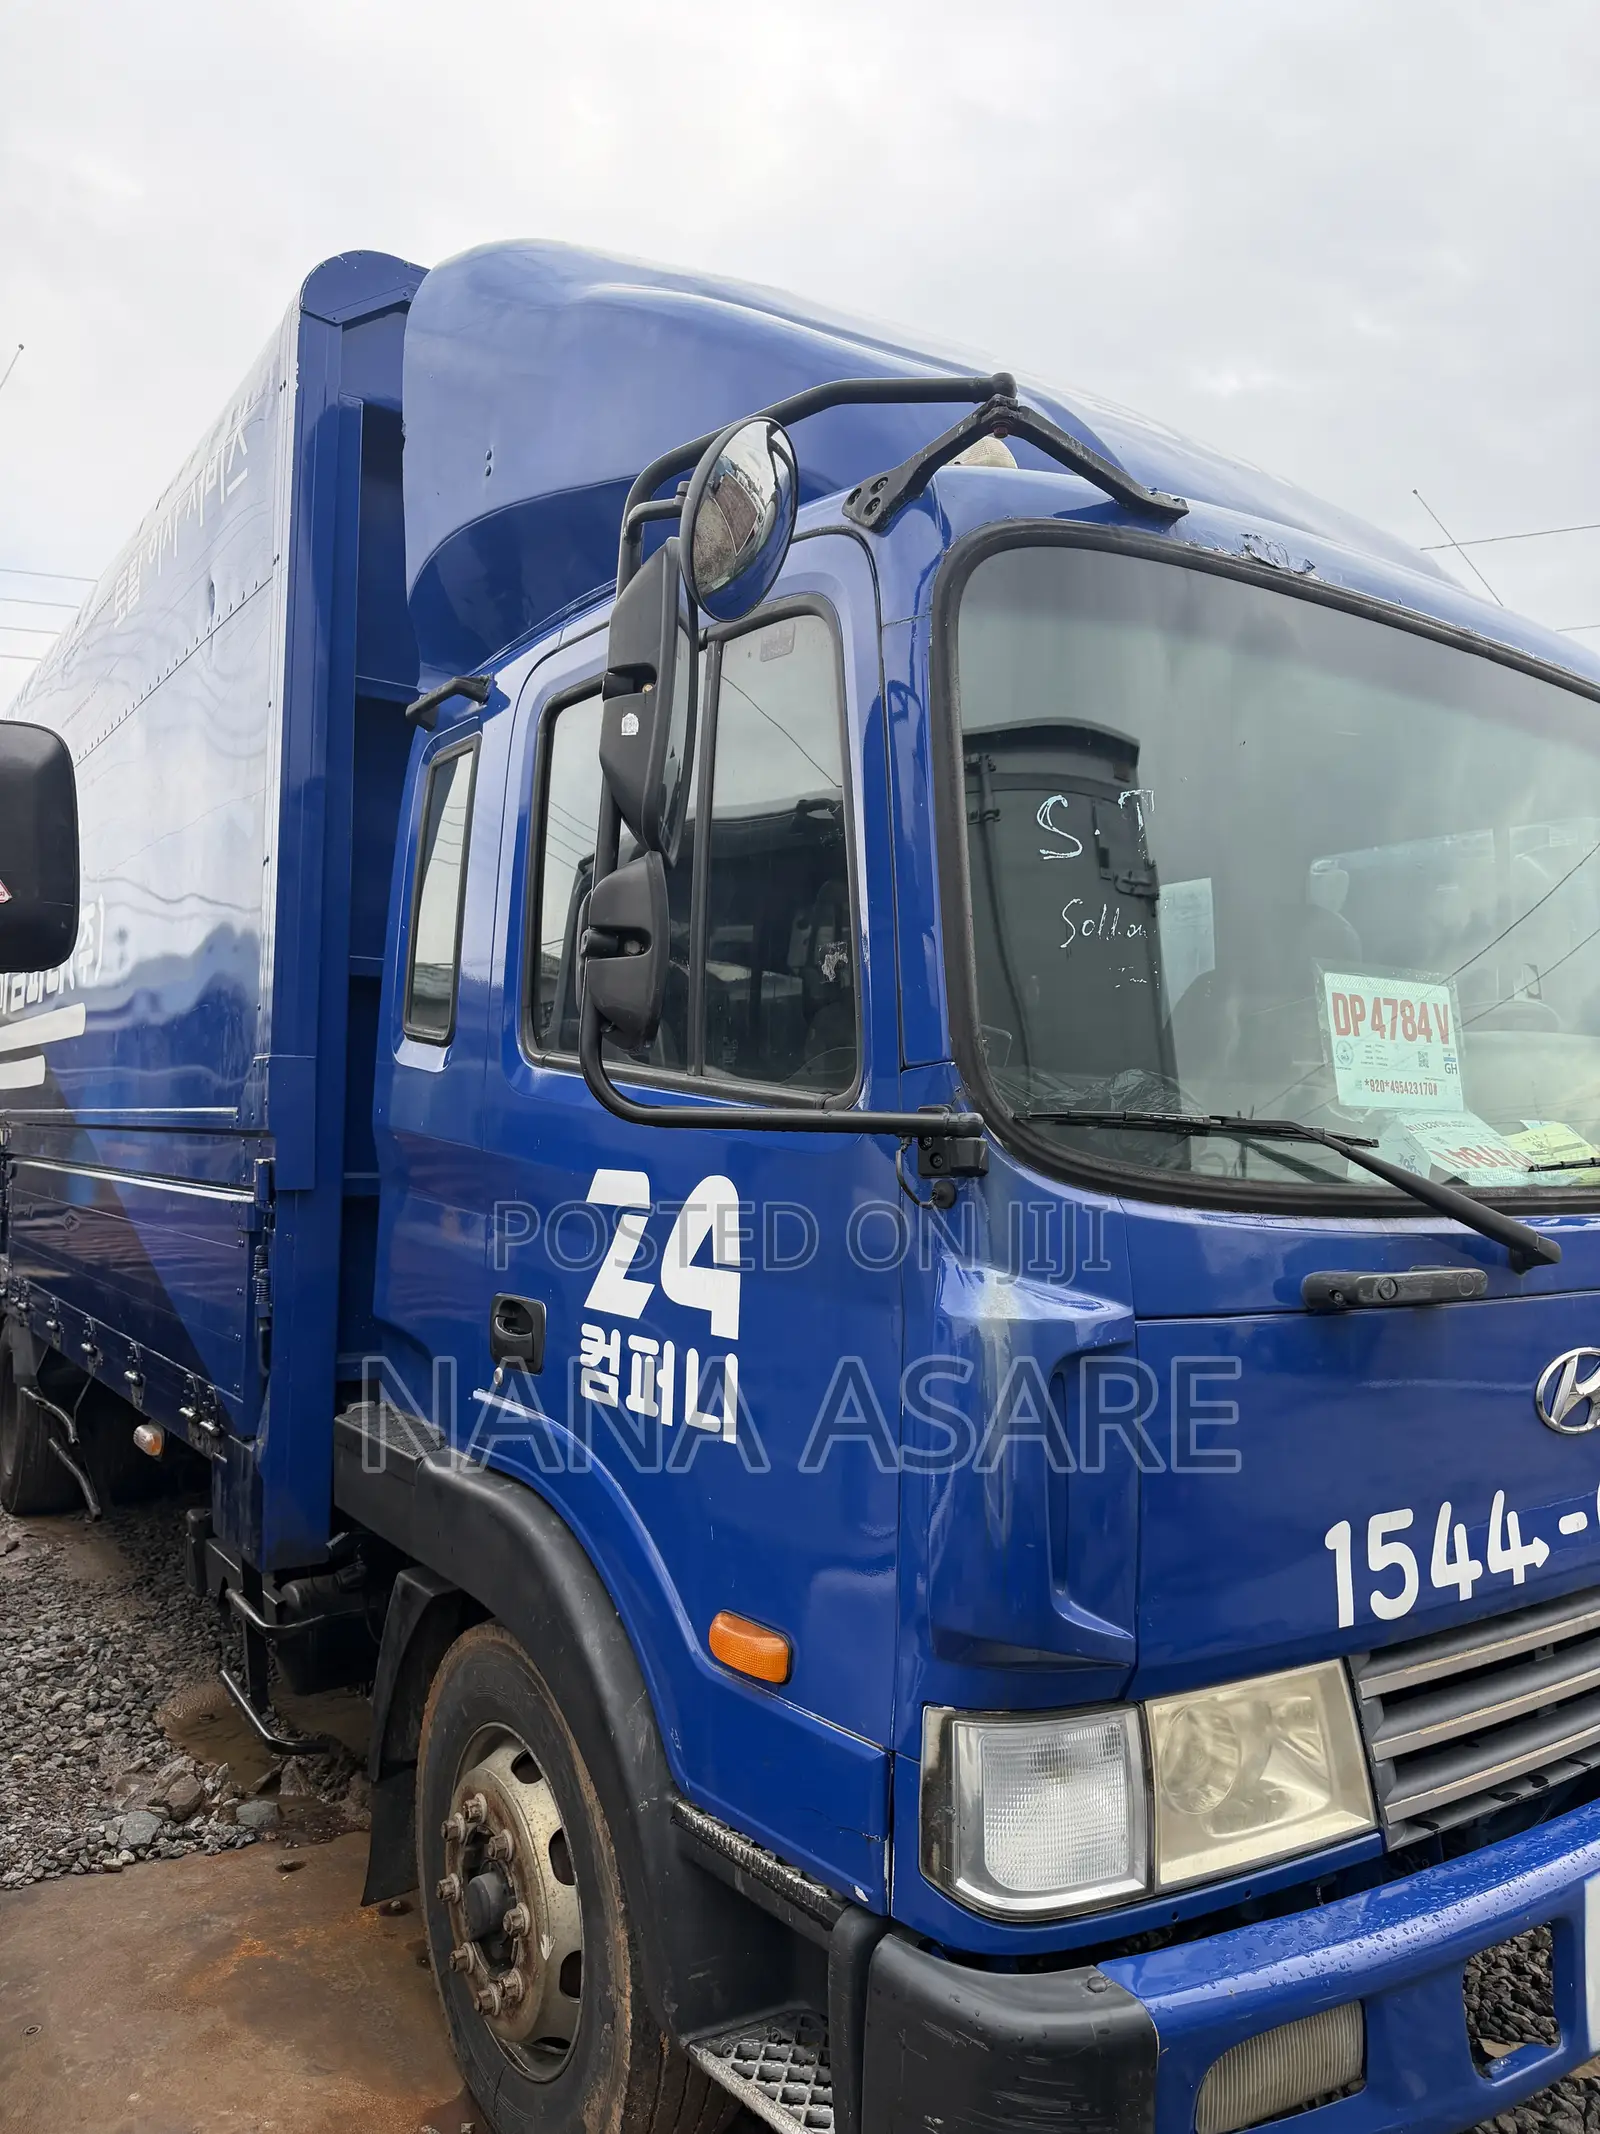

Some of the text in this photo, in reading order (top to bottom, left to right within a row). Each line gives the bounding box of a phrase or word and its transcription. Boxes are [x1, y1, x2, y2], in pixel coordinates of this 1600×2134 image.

[1331, 992, 1450, 1045] DP 4784 V
[1444, 1062, 1458, 1075] GH
[584, 1168, 741, 1340] 24
[579, 1323, 739, 1445] 컴퍼니
[1325, 1483, 1600, 1629] 1544-
